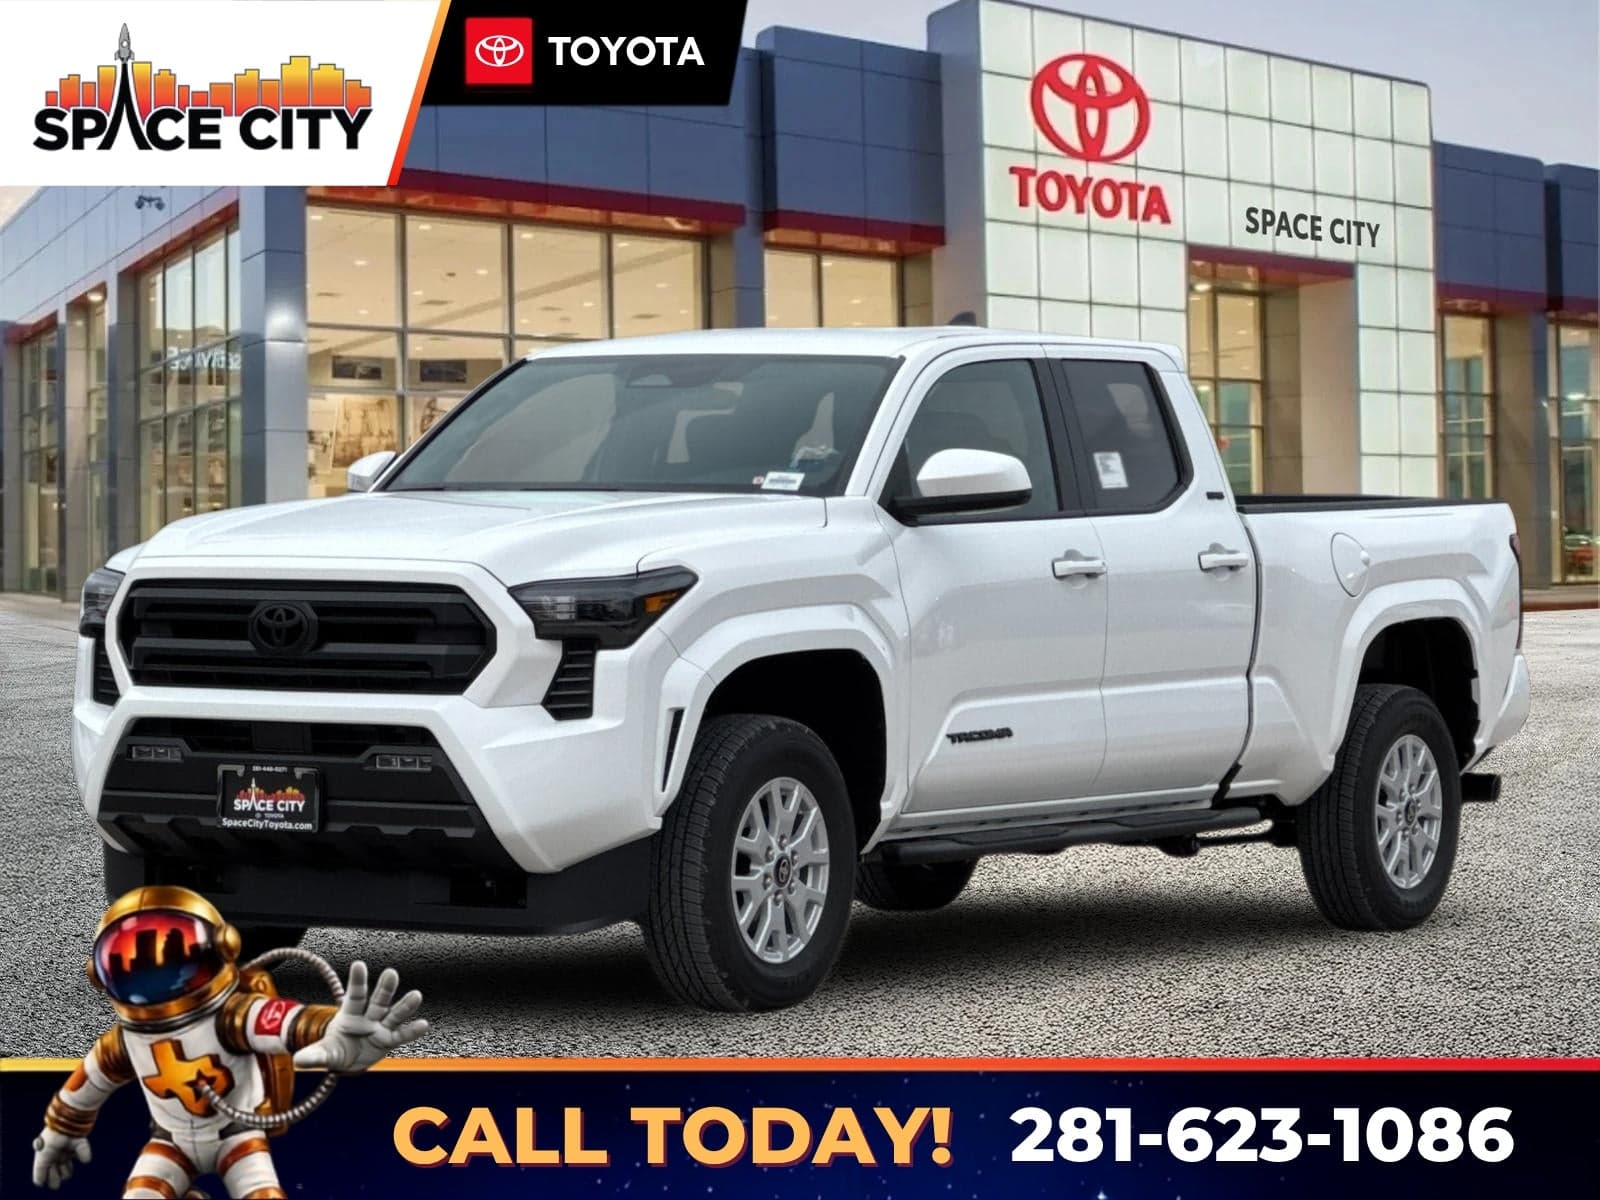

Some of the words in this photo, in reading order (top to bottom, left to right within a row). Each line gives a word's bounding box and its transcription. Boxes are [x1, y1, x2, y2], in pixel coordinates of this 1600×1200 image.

[1008, 165, 1171, 225] TOYOTA
[1245, 206, 1323, 242] SPACE
[1329, 217, 1381, 249] CITY
[233, 798, 275, 811] SPACE
[277, 799, 305, 812] CITY
[222, 818, 312, 830] SpaceCityToyota.com
